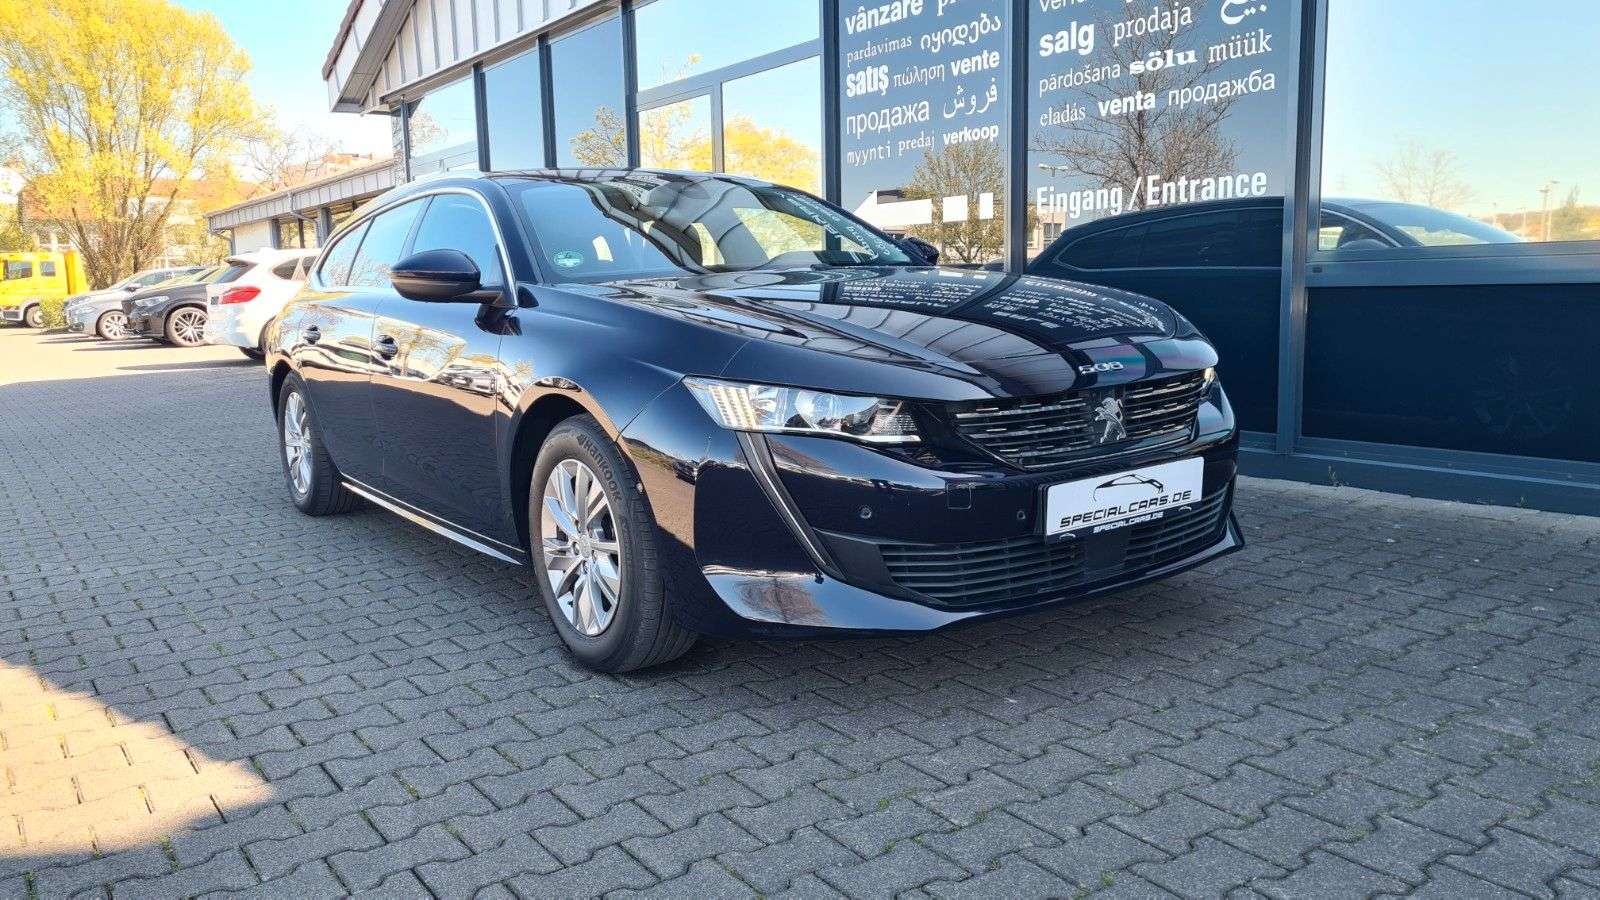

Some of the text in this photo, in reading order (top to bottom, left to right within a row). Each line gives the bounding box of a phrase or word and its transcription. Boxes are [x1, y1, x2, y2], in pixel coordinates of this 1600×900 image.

[845, 0, 924, 35] vânzare
[1113, 2, 1193, 47] prodaja
[847, 34, 913, 67] pardavimas
[1039, 21, 1095, 57] salg
[1208, 28, 1273, 64] müük
[893, 63, 945, 88] πώληση
[950, 49, 1000, 77] vente
[1129, 49, 1198, 75] sölu
[1098, 90, 1156, 117] venta
[1168, 69, 1276, 108] продажба
[846, 100, 930, 140] продажа
[1040, 103, 1086, 127] eladás
[898, 130, 935, 157] predaj
[942, 124, 999, 145] verkoop
[847, 140, 891, 167] myynti
[1036, 185, 1123, 219] Eingang
[1147, 171, 1267, 206] Entrance
[1059, 490, 1192, 528] SPECIALCARS.DE
